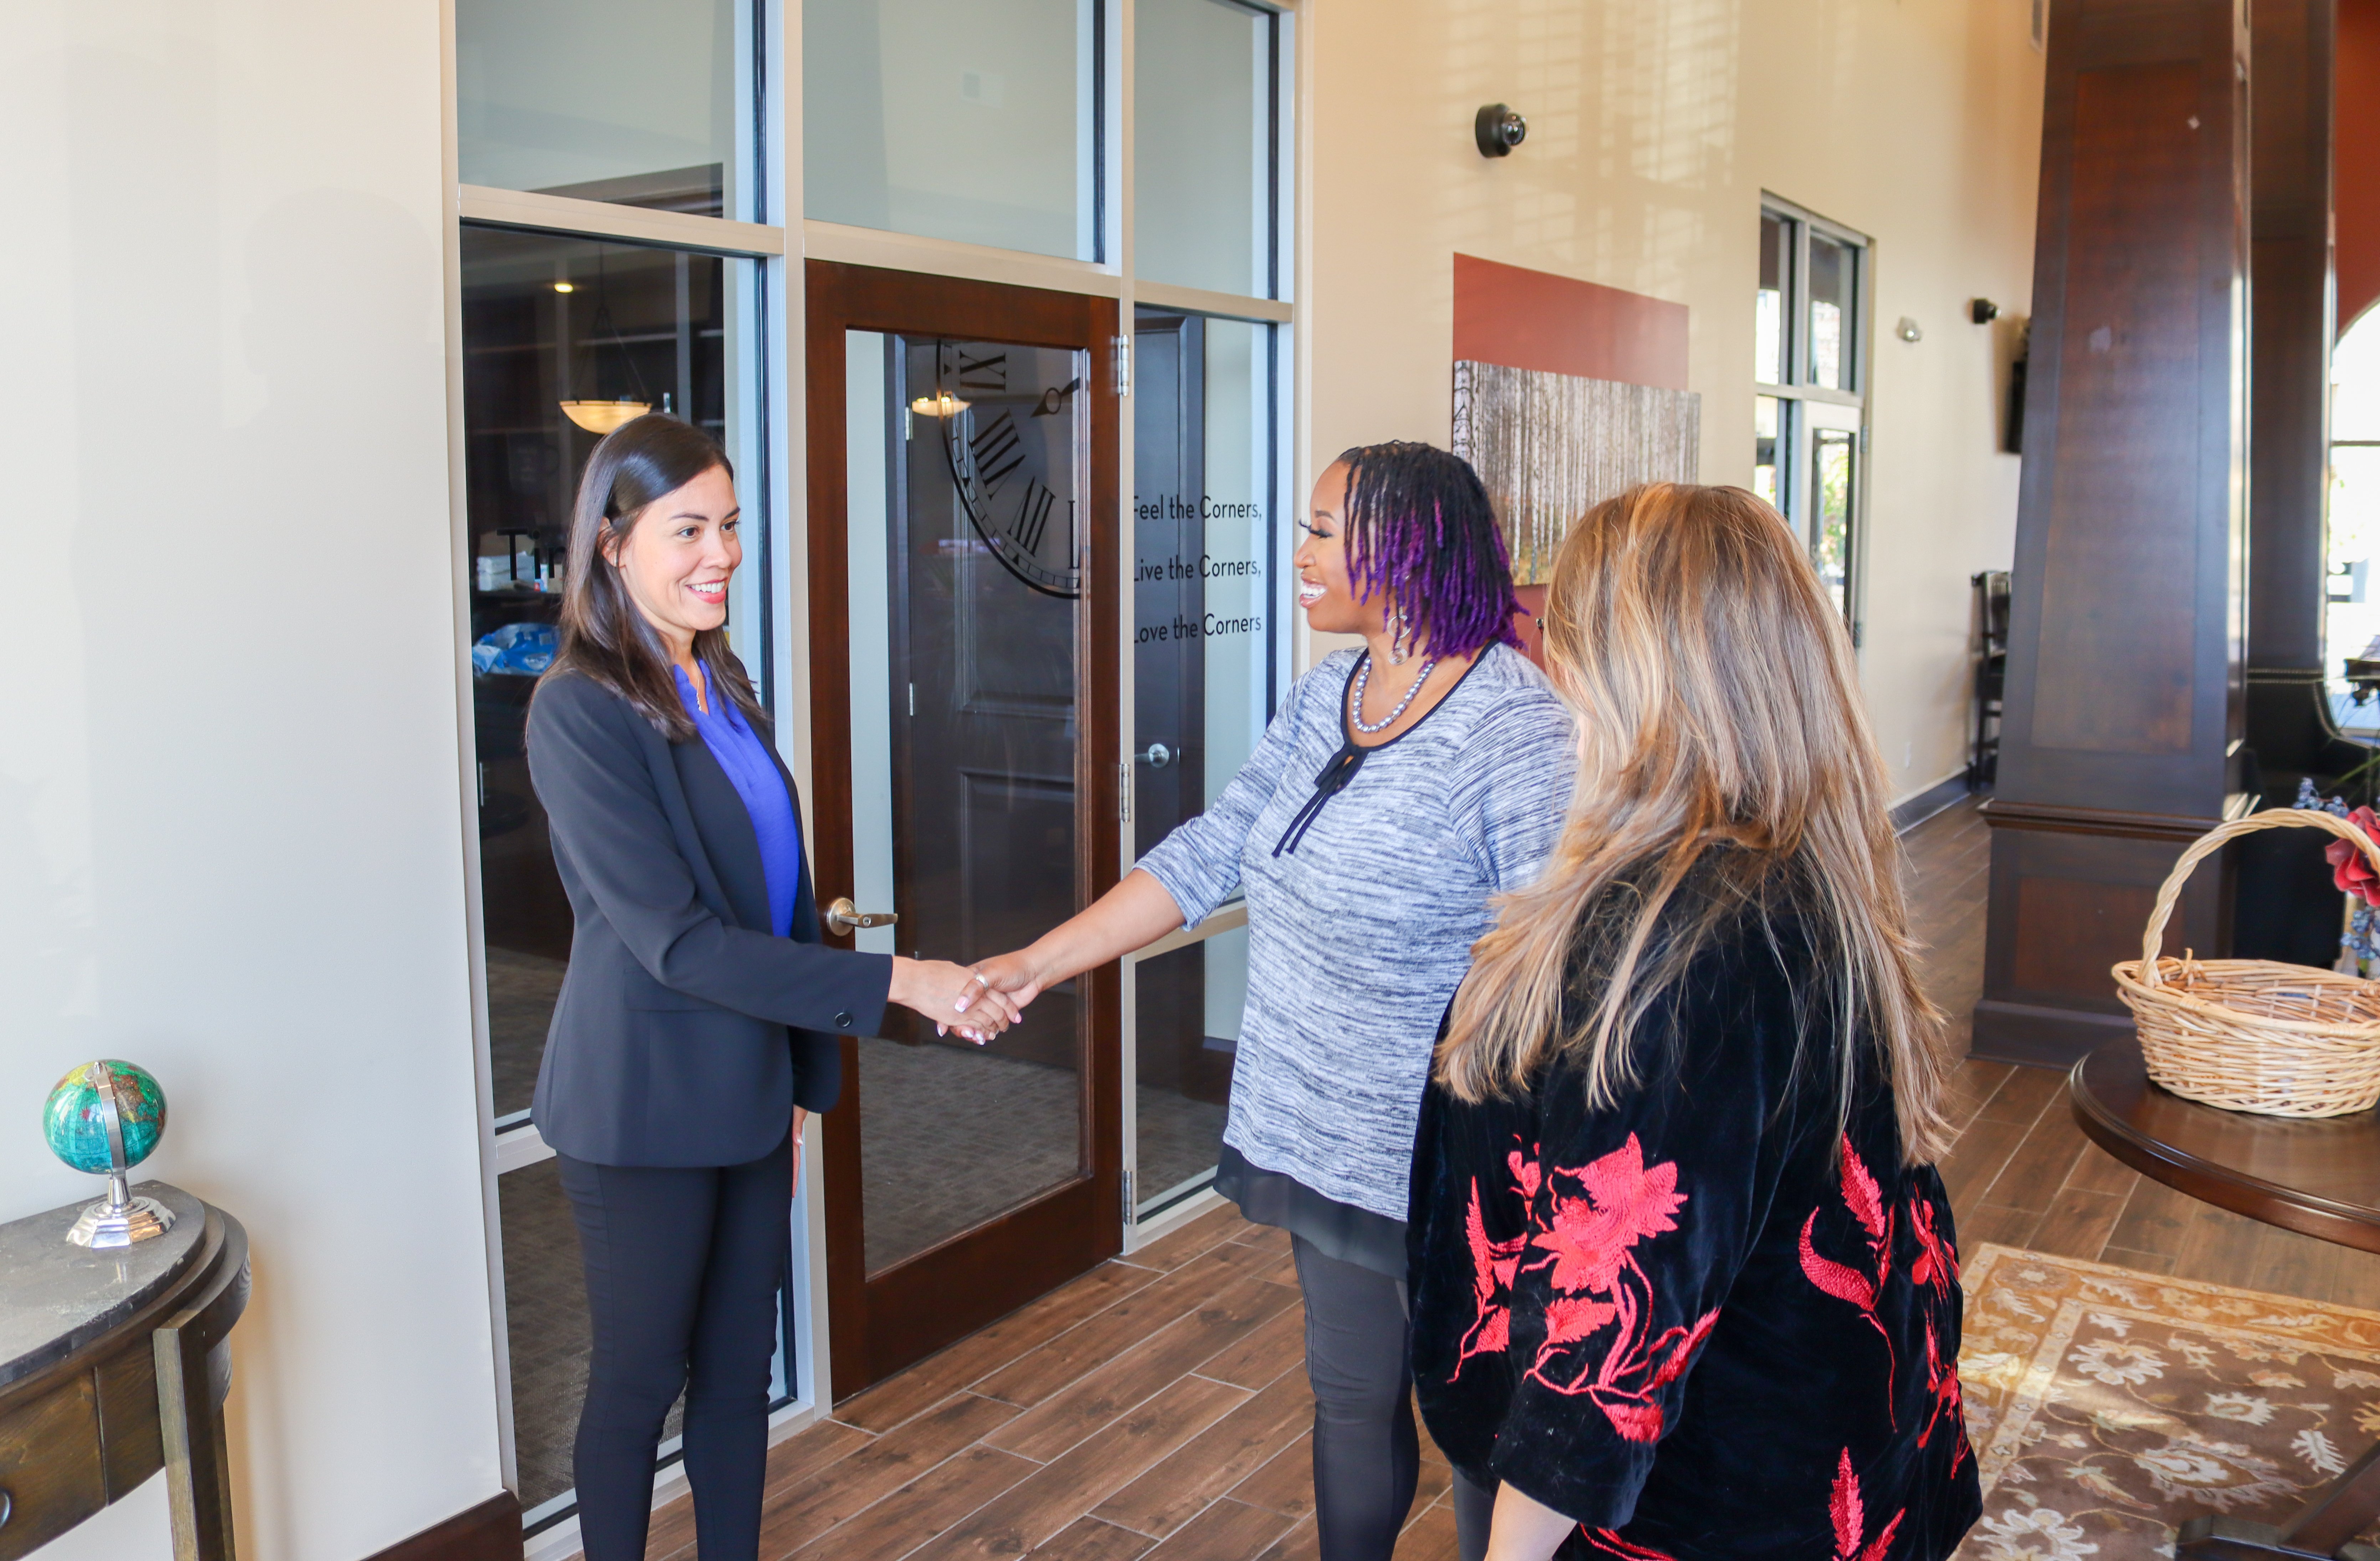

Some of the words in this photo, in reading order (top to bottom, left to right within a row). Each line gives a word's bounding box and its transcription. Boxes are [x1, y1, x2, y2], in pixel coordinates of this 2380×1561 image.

[1170, 494, 1194, 519] the
[1200, 495, 1262, 521] Corners,
[1169, 555, 1194, 580] the
[1200, 554, 1261, 578] Corners,
[1174, 614, 1198, 639] the
[1204, 613, 1261, 636] Corners
